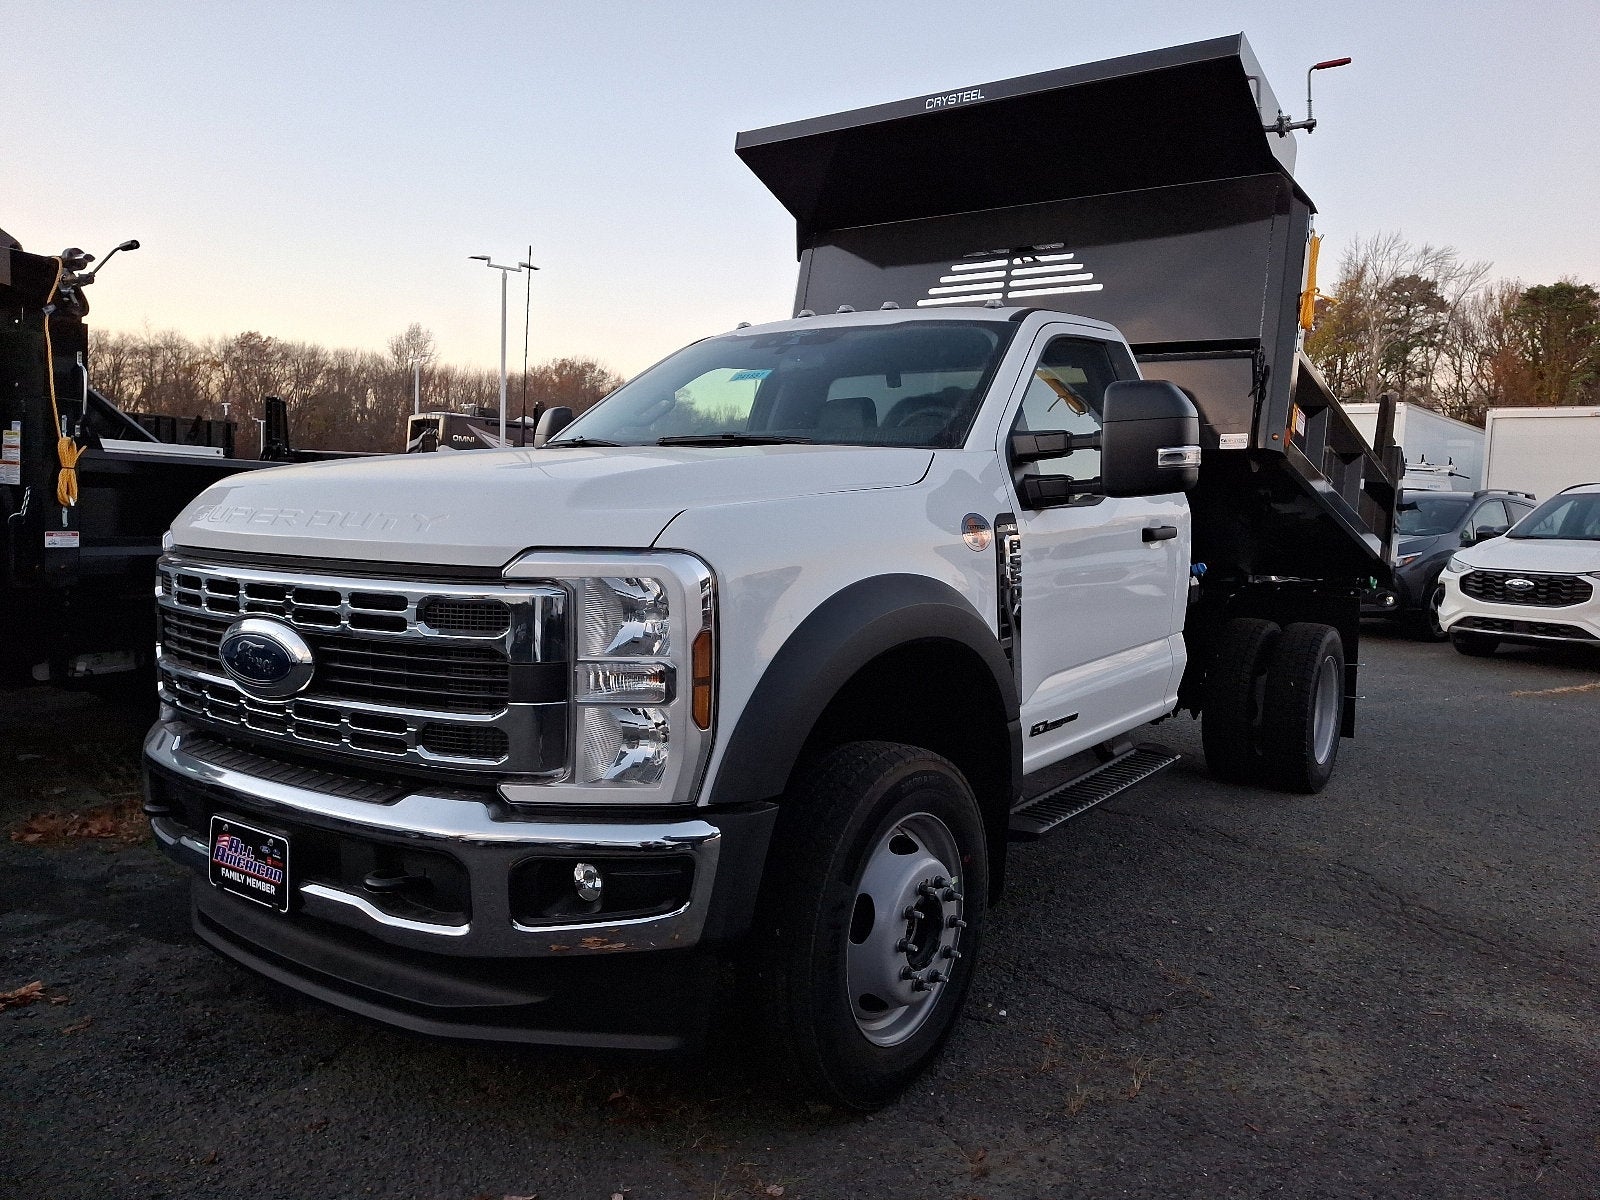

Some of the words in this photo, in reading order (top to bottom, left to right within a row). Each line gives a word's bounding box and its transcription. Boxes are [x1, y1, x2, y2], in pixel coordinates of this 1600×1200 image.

[925, 89, 985, 109] CRYSTEEL
[452, 434, 475, 443] OMNI
[190, 504, 304, 527] SUPER
[305, 509, 450, 533] DUTY
[228, 836, 255, 860] ALL
[213, 845, 283, 883] AMERICAN
[221, 867, 245, 884] FAMILY
[246, 876, 276, 895] MEMBER
